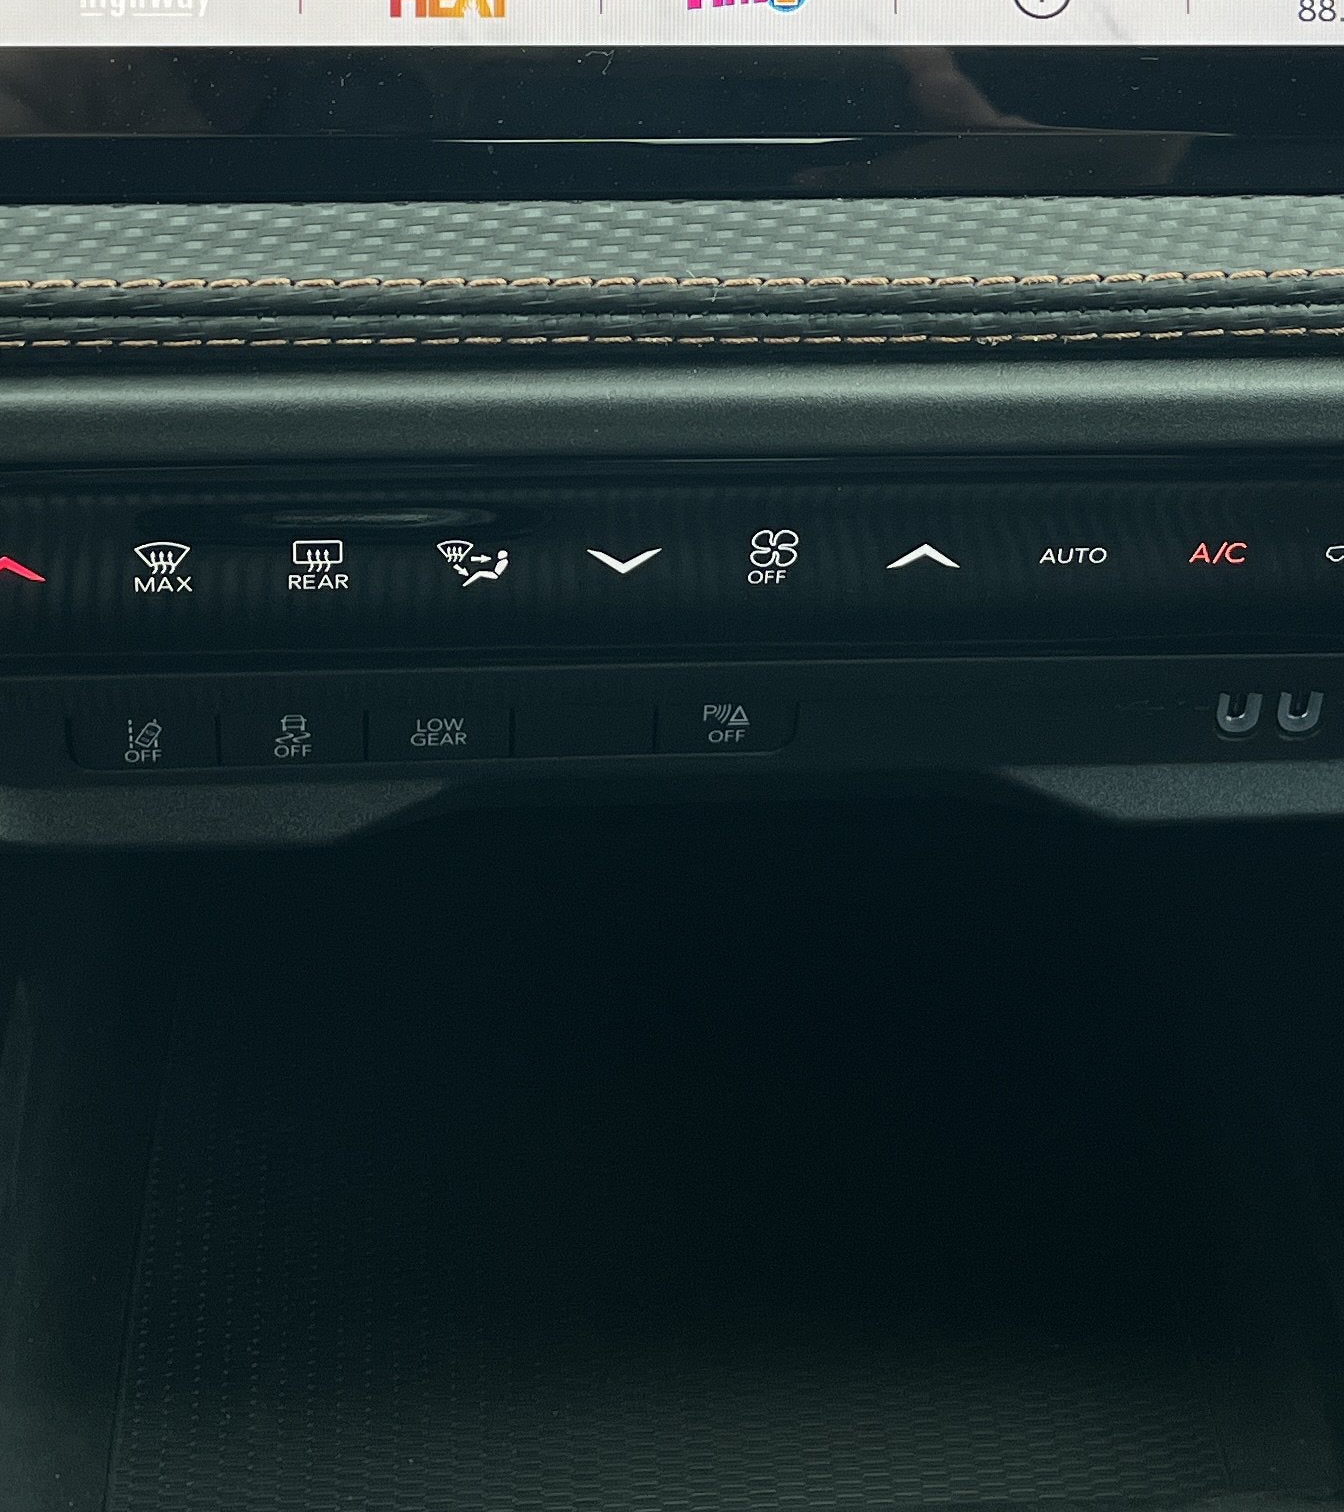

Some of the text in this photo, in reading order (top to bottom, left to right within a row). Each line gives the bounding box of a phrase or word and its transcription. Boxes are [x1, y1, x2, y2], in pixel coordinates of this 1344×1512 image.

[1039, 547, 1108, 565] AUTO
[1188, 541, 1248, 565] A/C
[134, 576, 193, 593] MAX
[288, 573, 349, 590] REAR
[747, 569, 787, 585] OFF
[416, 717, 465, 732] LOW
[409, 730, 468, 747] GEAR
[707, 729, 745, 743] OFF
[124, 748, 163, 763] OFF
[273, 743, 312, 758] OFF
